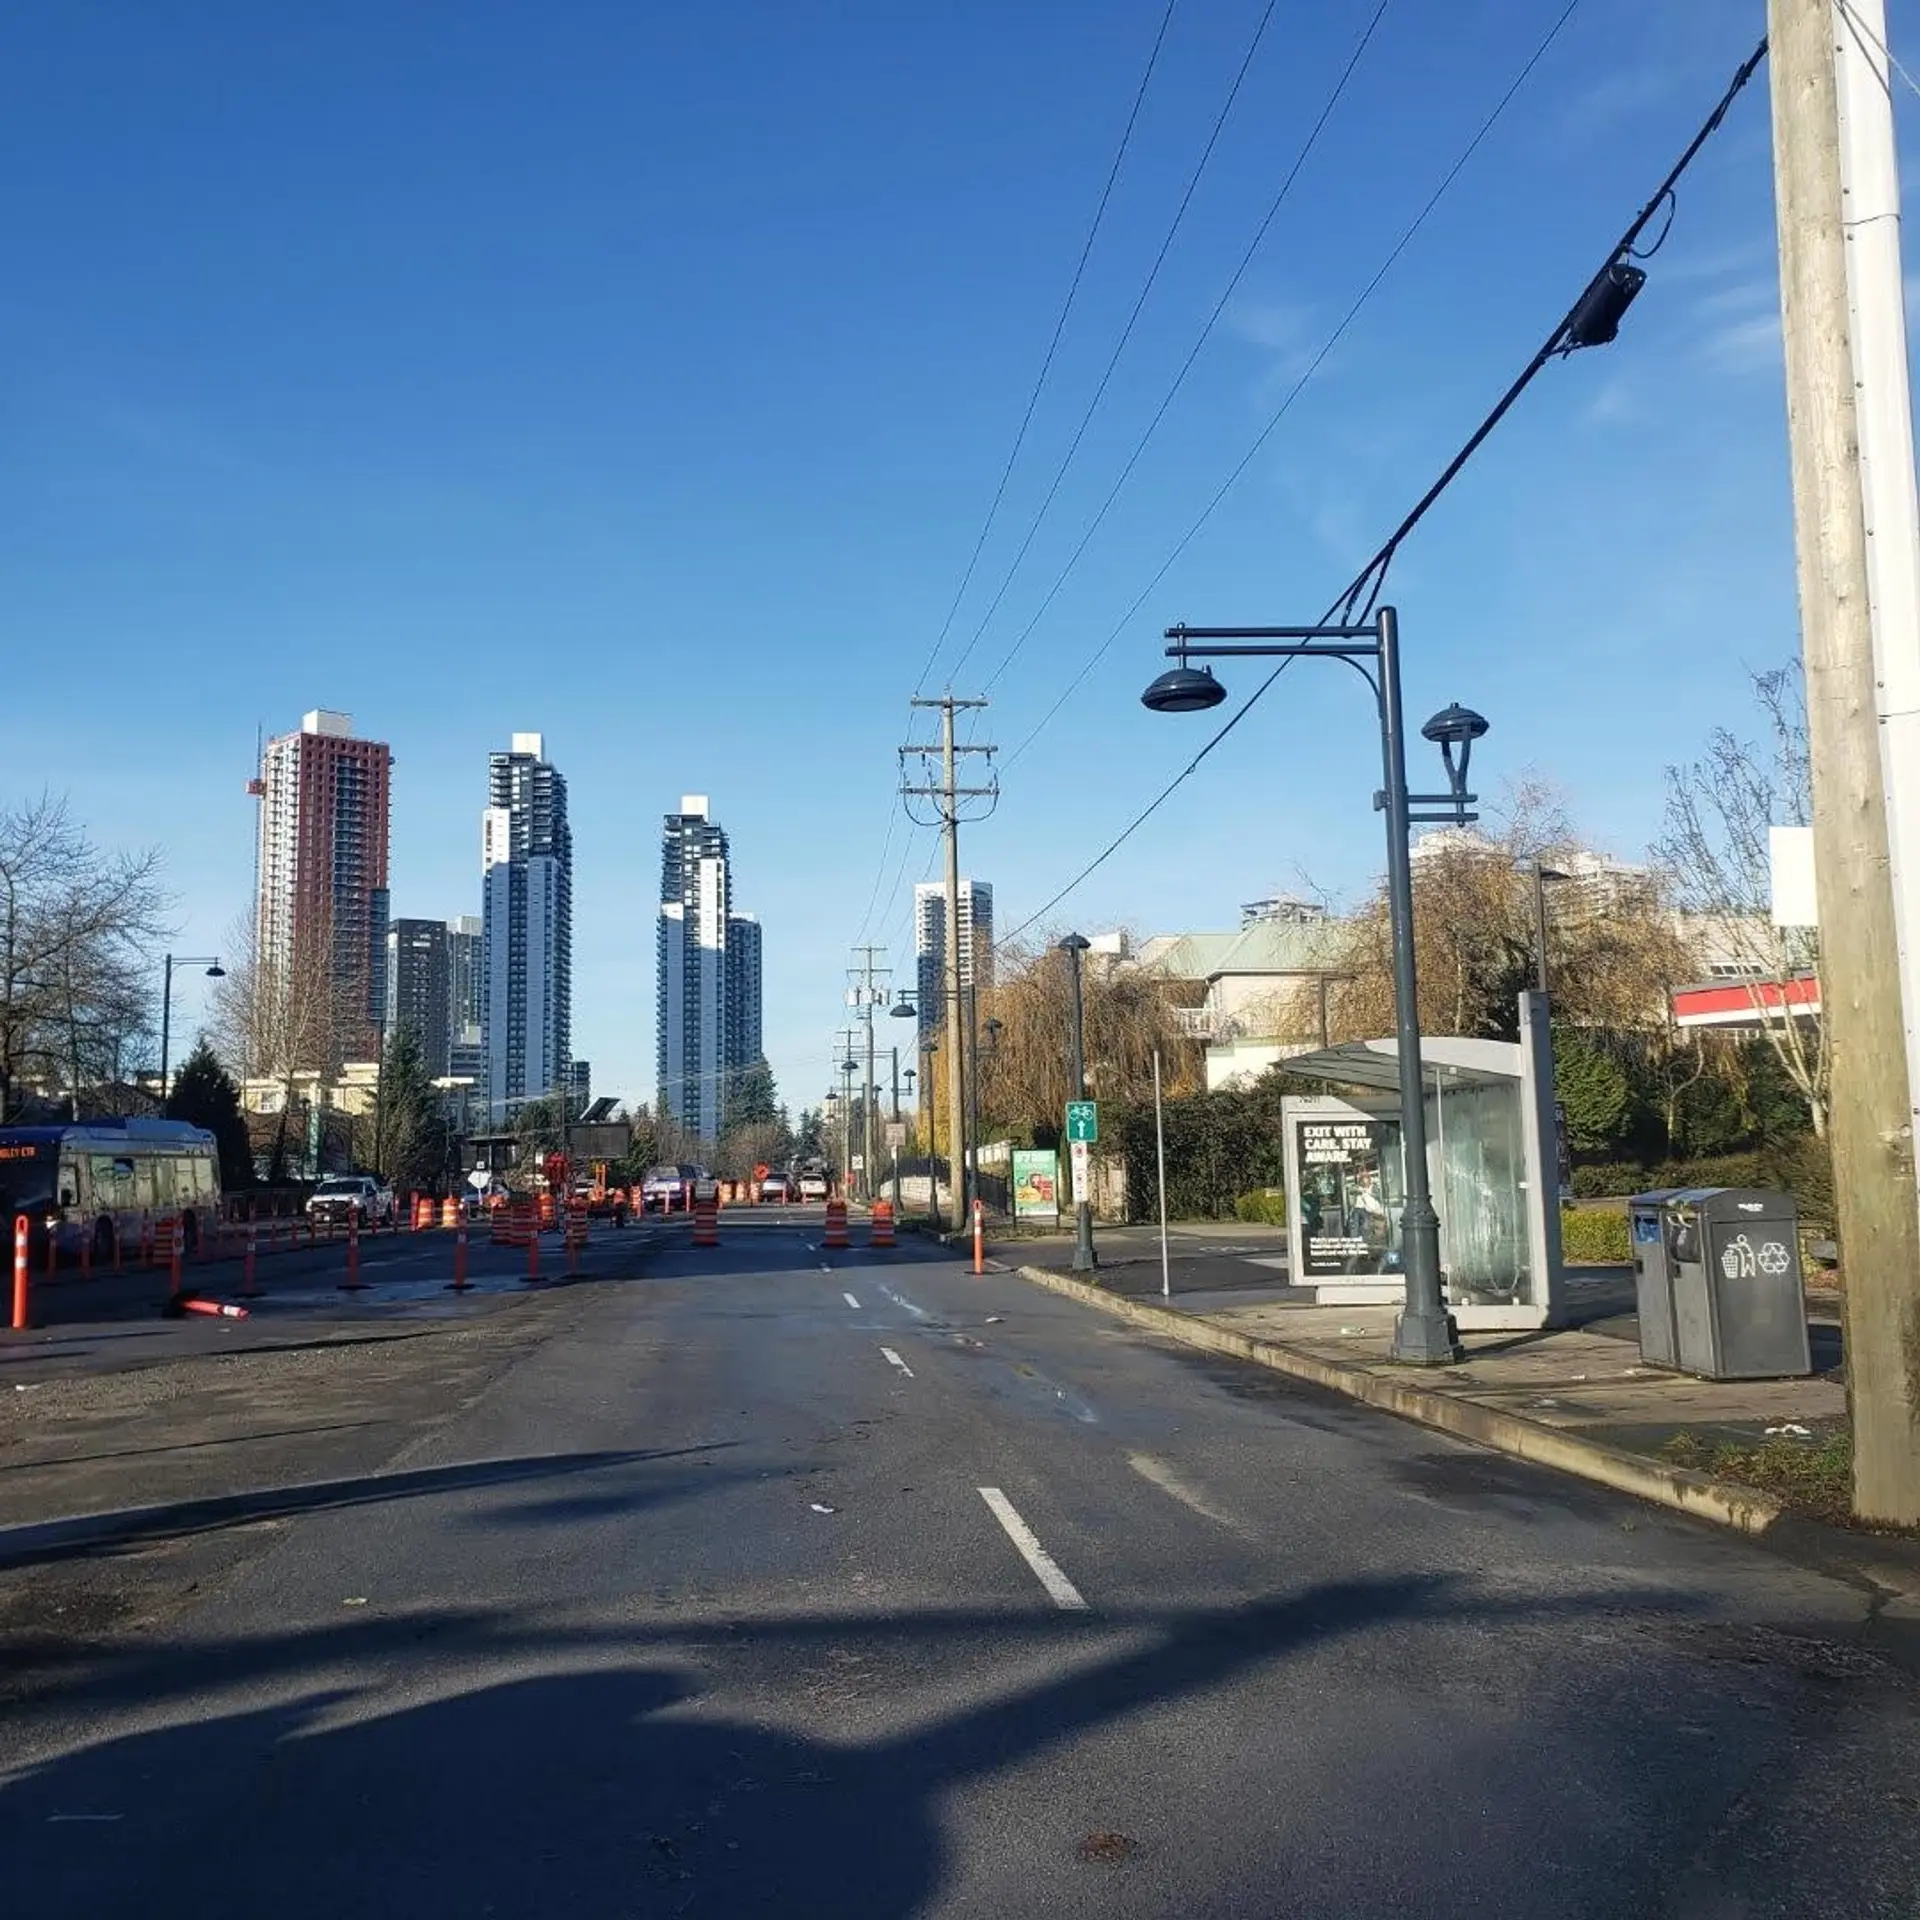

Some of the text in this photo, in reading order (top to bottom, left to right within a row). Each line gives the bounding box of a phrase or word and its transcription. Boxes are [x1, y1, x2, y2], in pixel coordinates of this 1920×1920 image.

[1303, 1125, 1367, 1137] EXIT WITH
[1304, 1138, 1372, 1150] CARE. STAY
[1305, 1150, 1352, 1163] AWARE.
